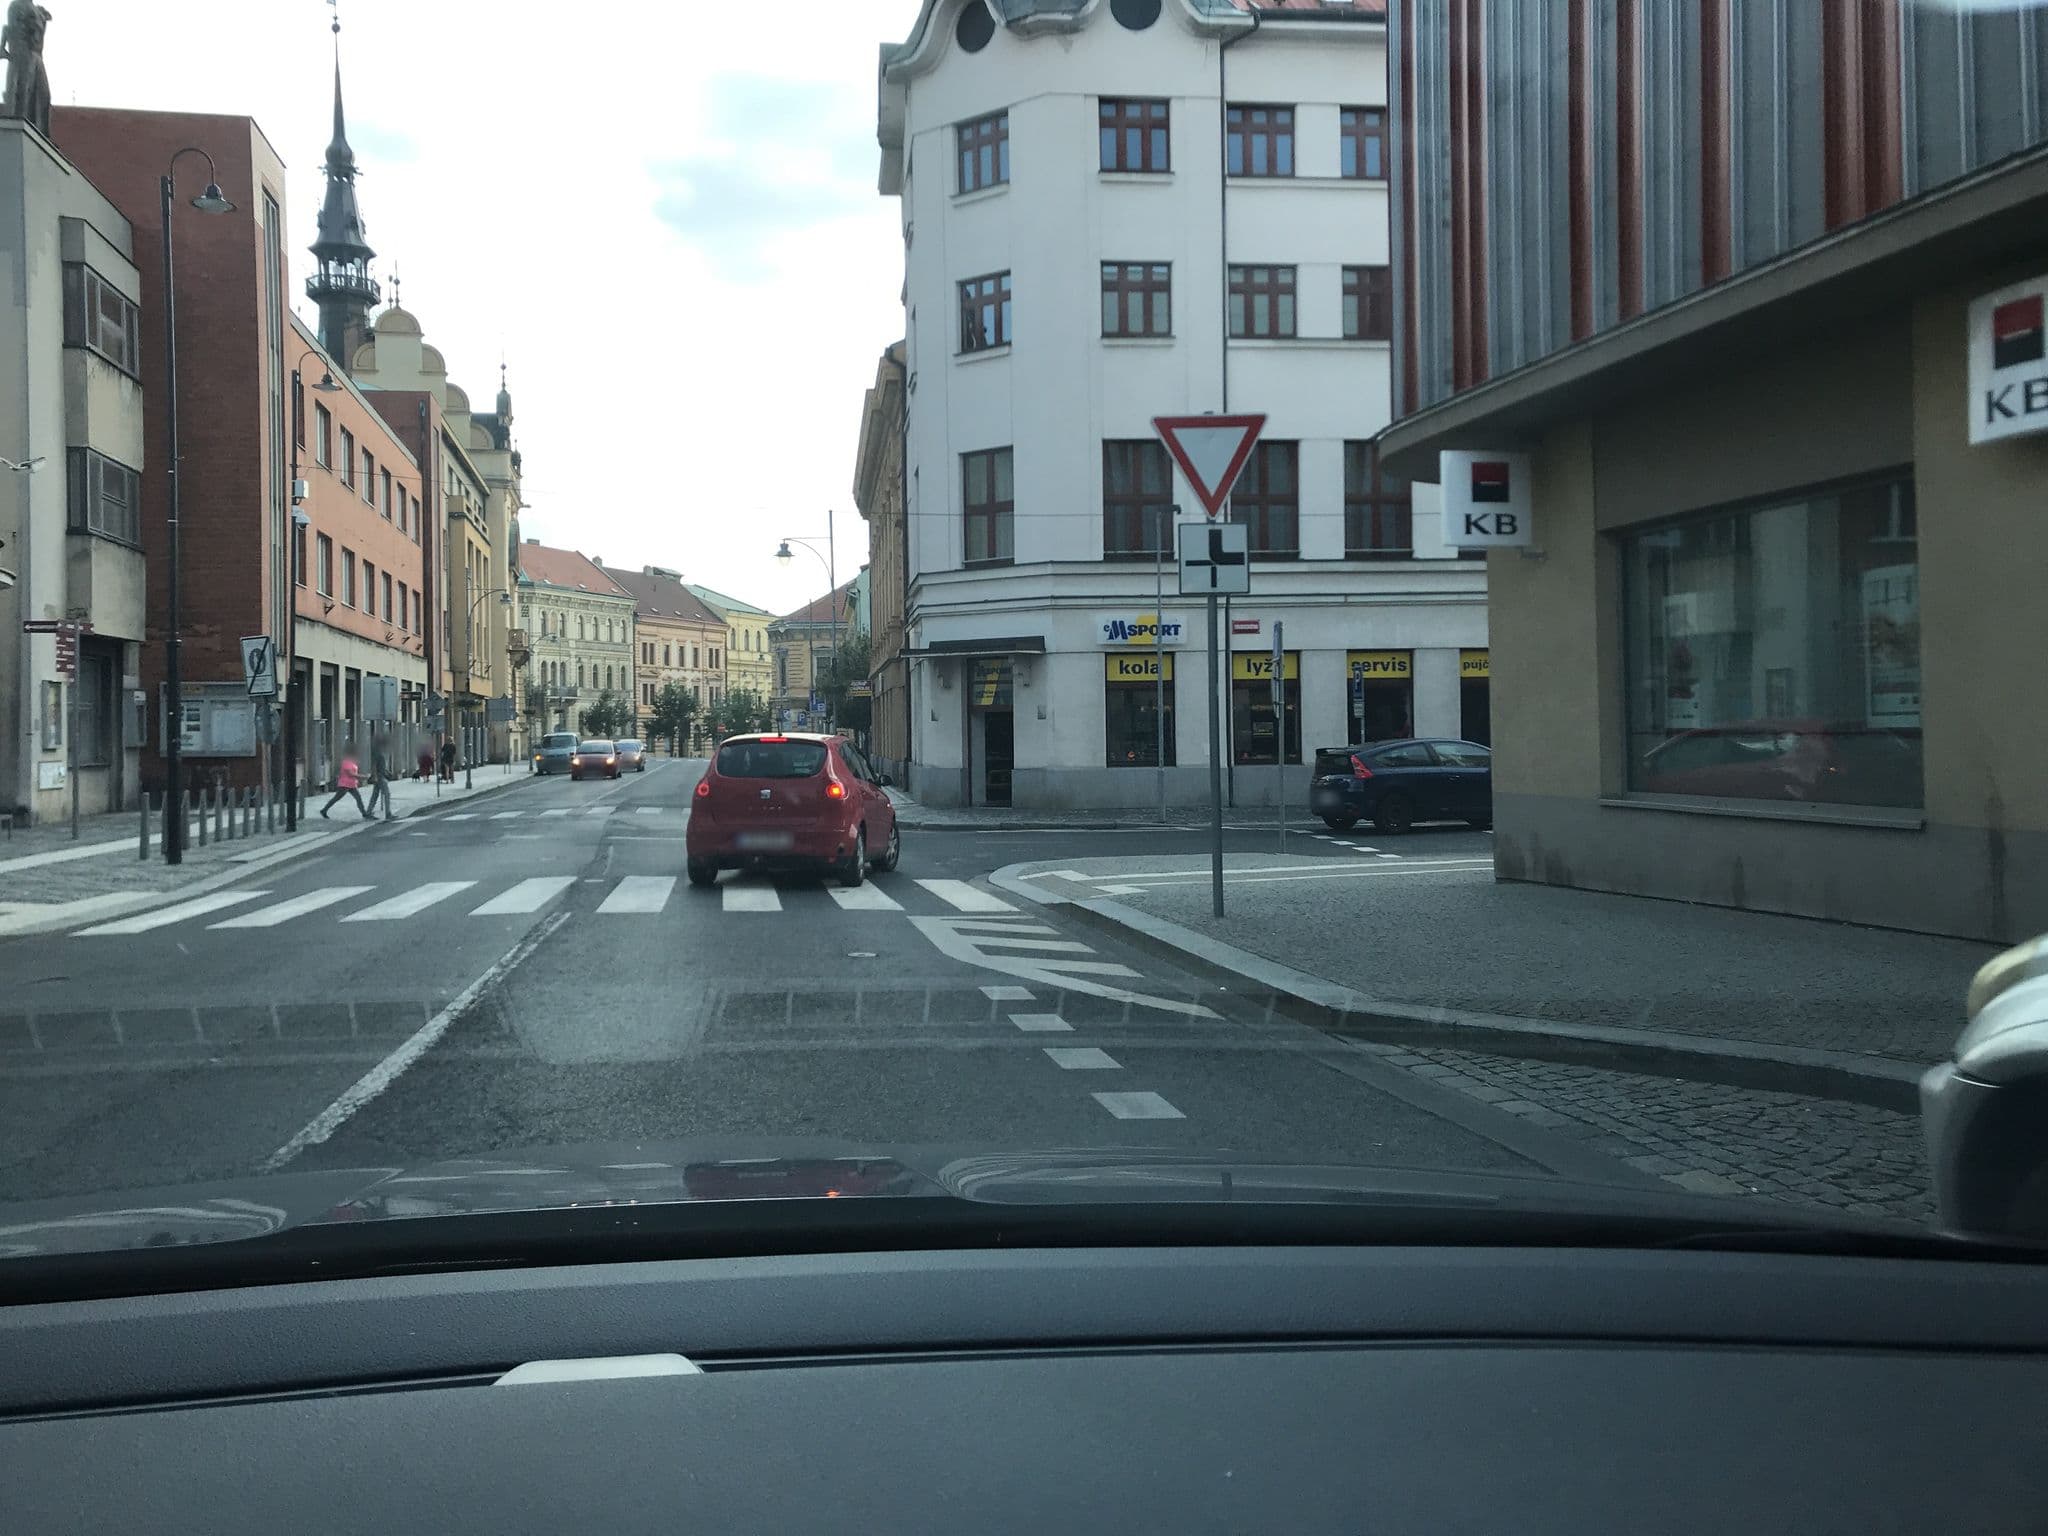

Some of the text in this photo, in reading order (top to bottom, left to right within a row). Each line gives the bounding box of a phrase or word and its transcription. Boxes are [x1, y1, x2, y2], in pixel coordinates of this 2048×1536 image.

[1985, 377, 2048, 423] KB
[1464, 513, 1518, 535] KB
[1119, 659, 1162, 675] kola
